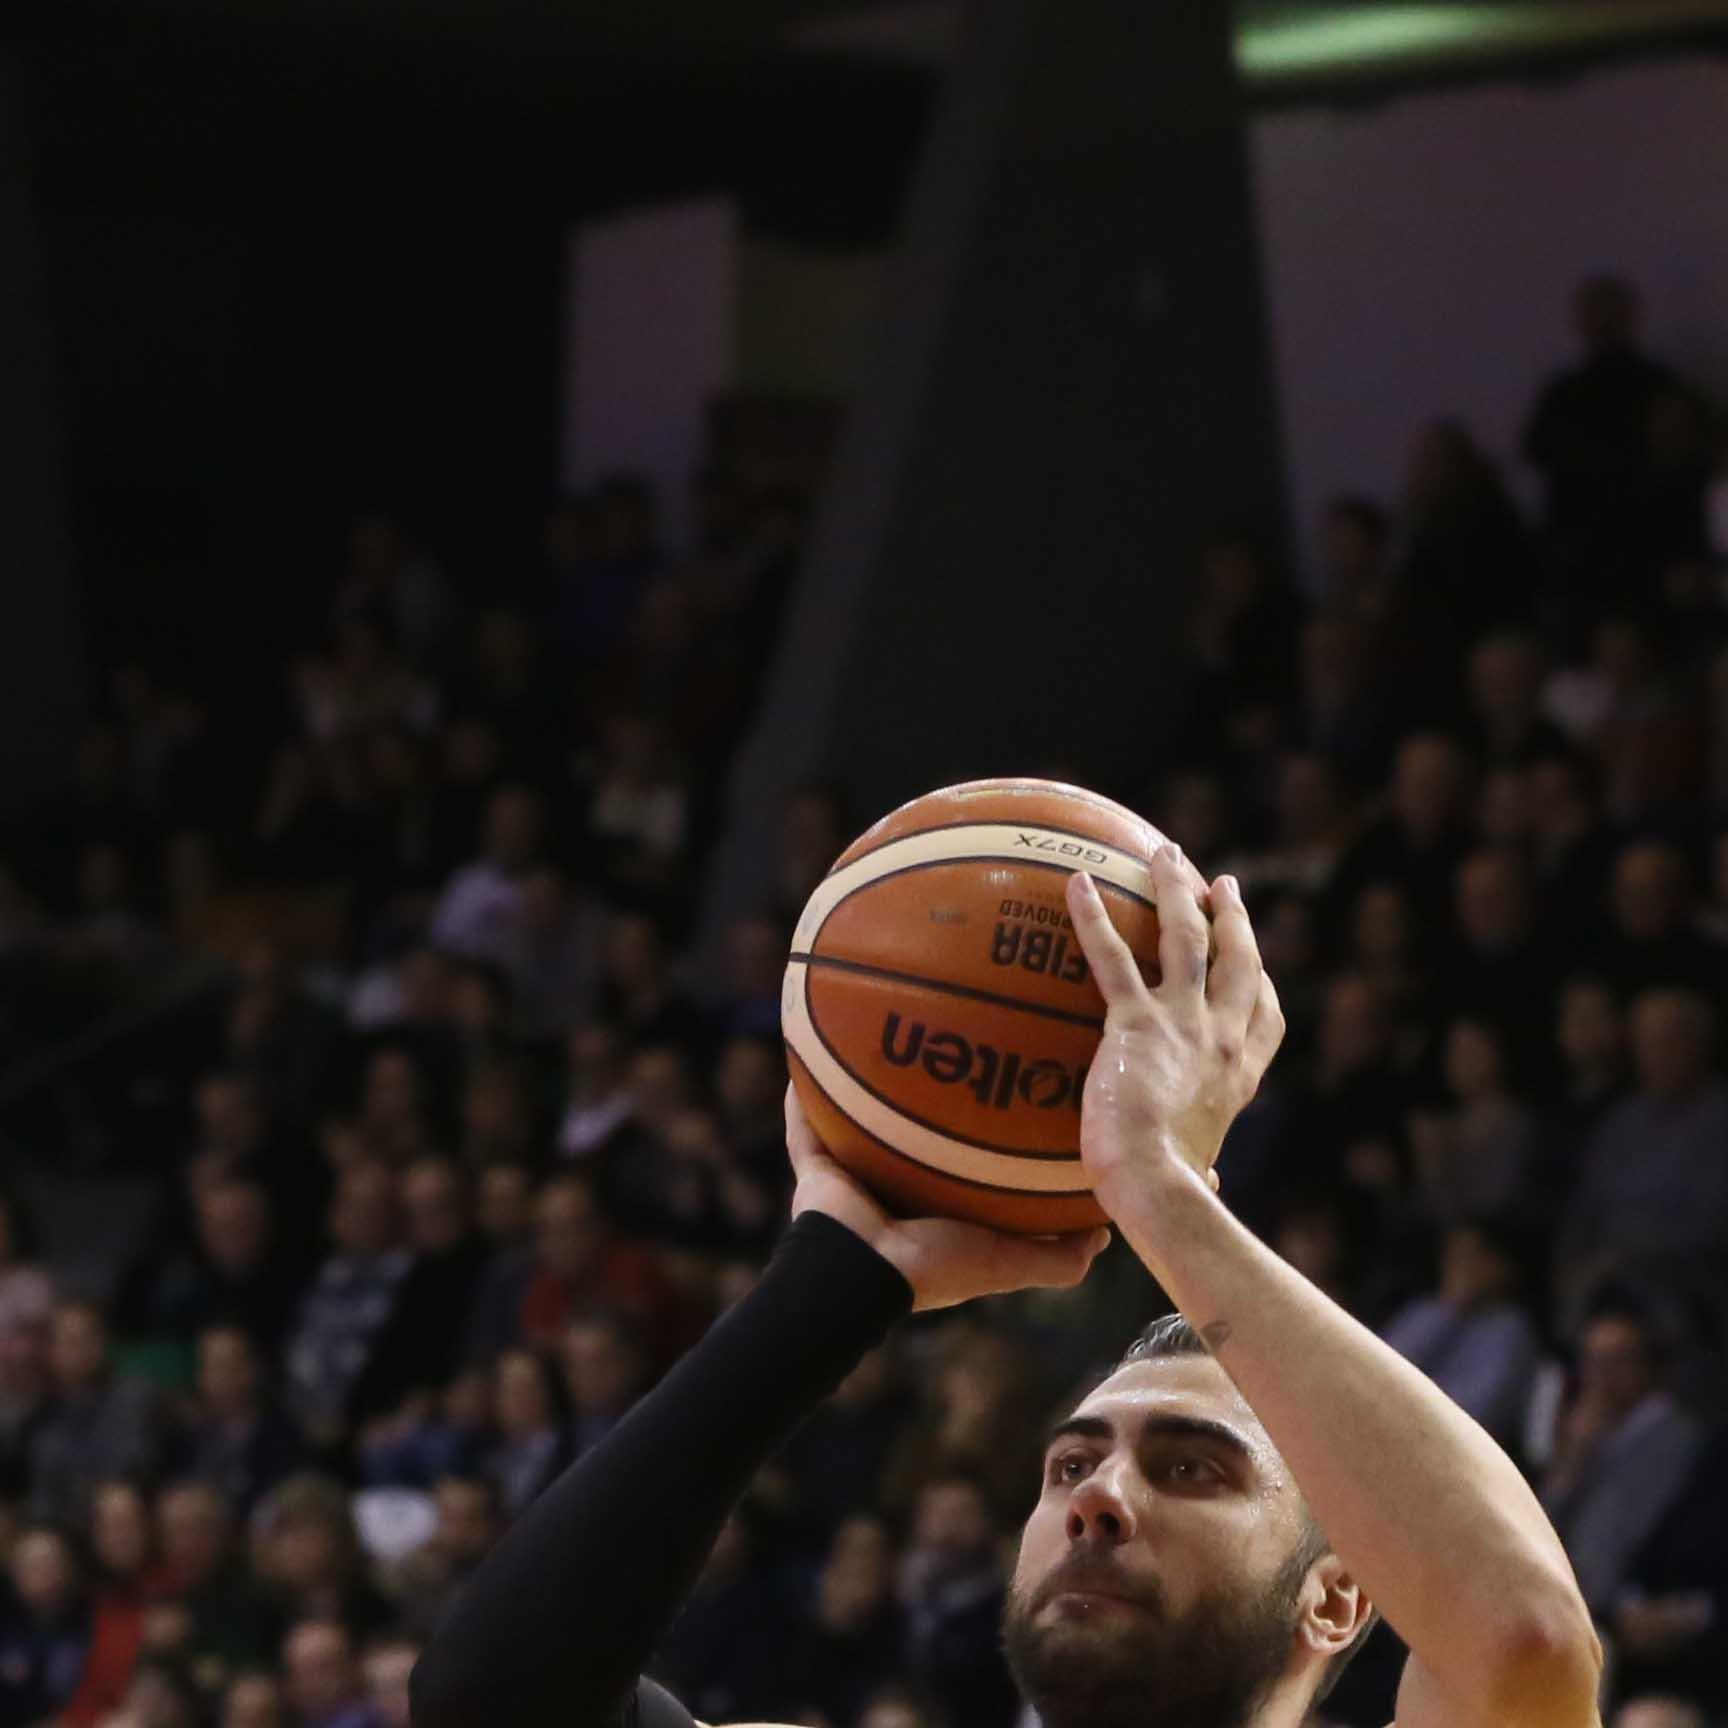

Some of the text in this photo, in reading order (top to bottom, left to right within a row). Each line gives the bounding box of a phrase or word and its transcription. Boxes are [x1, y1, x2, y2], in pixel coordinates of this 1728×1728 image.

[1013, 832, 1108, 866] GG7X
[999, 899, 1075, 930] PROVED
[991, 921, 1092, 984] FIBA
[880, 1012, 1084, 1111] olten
